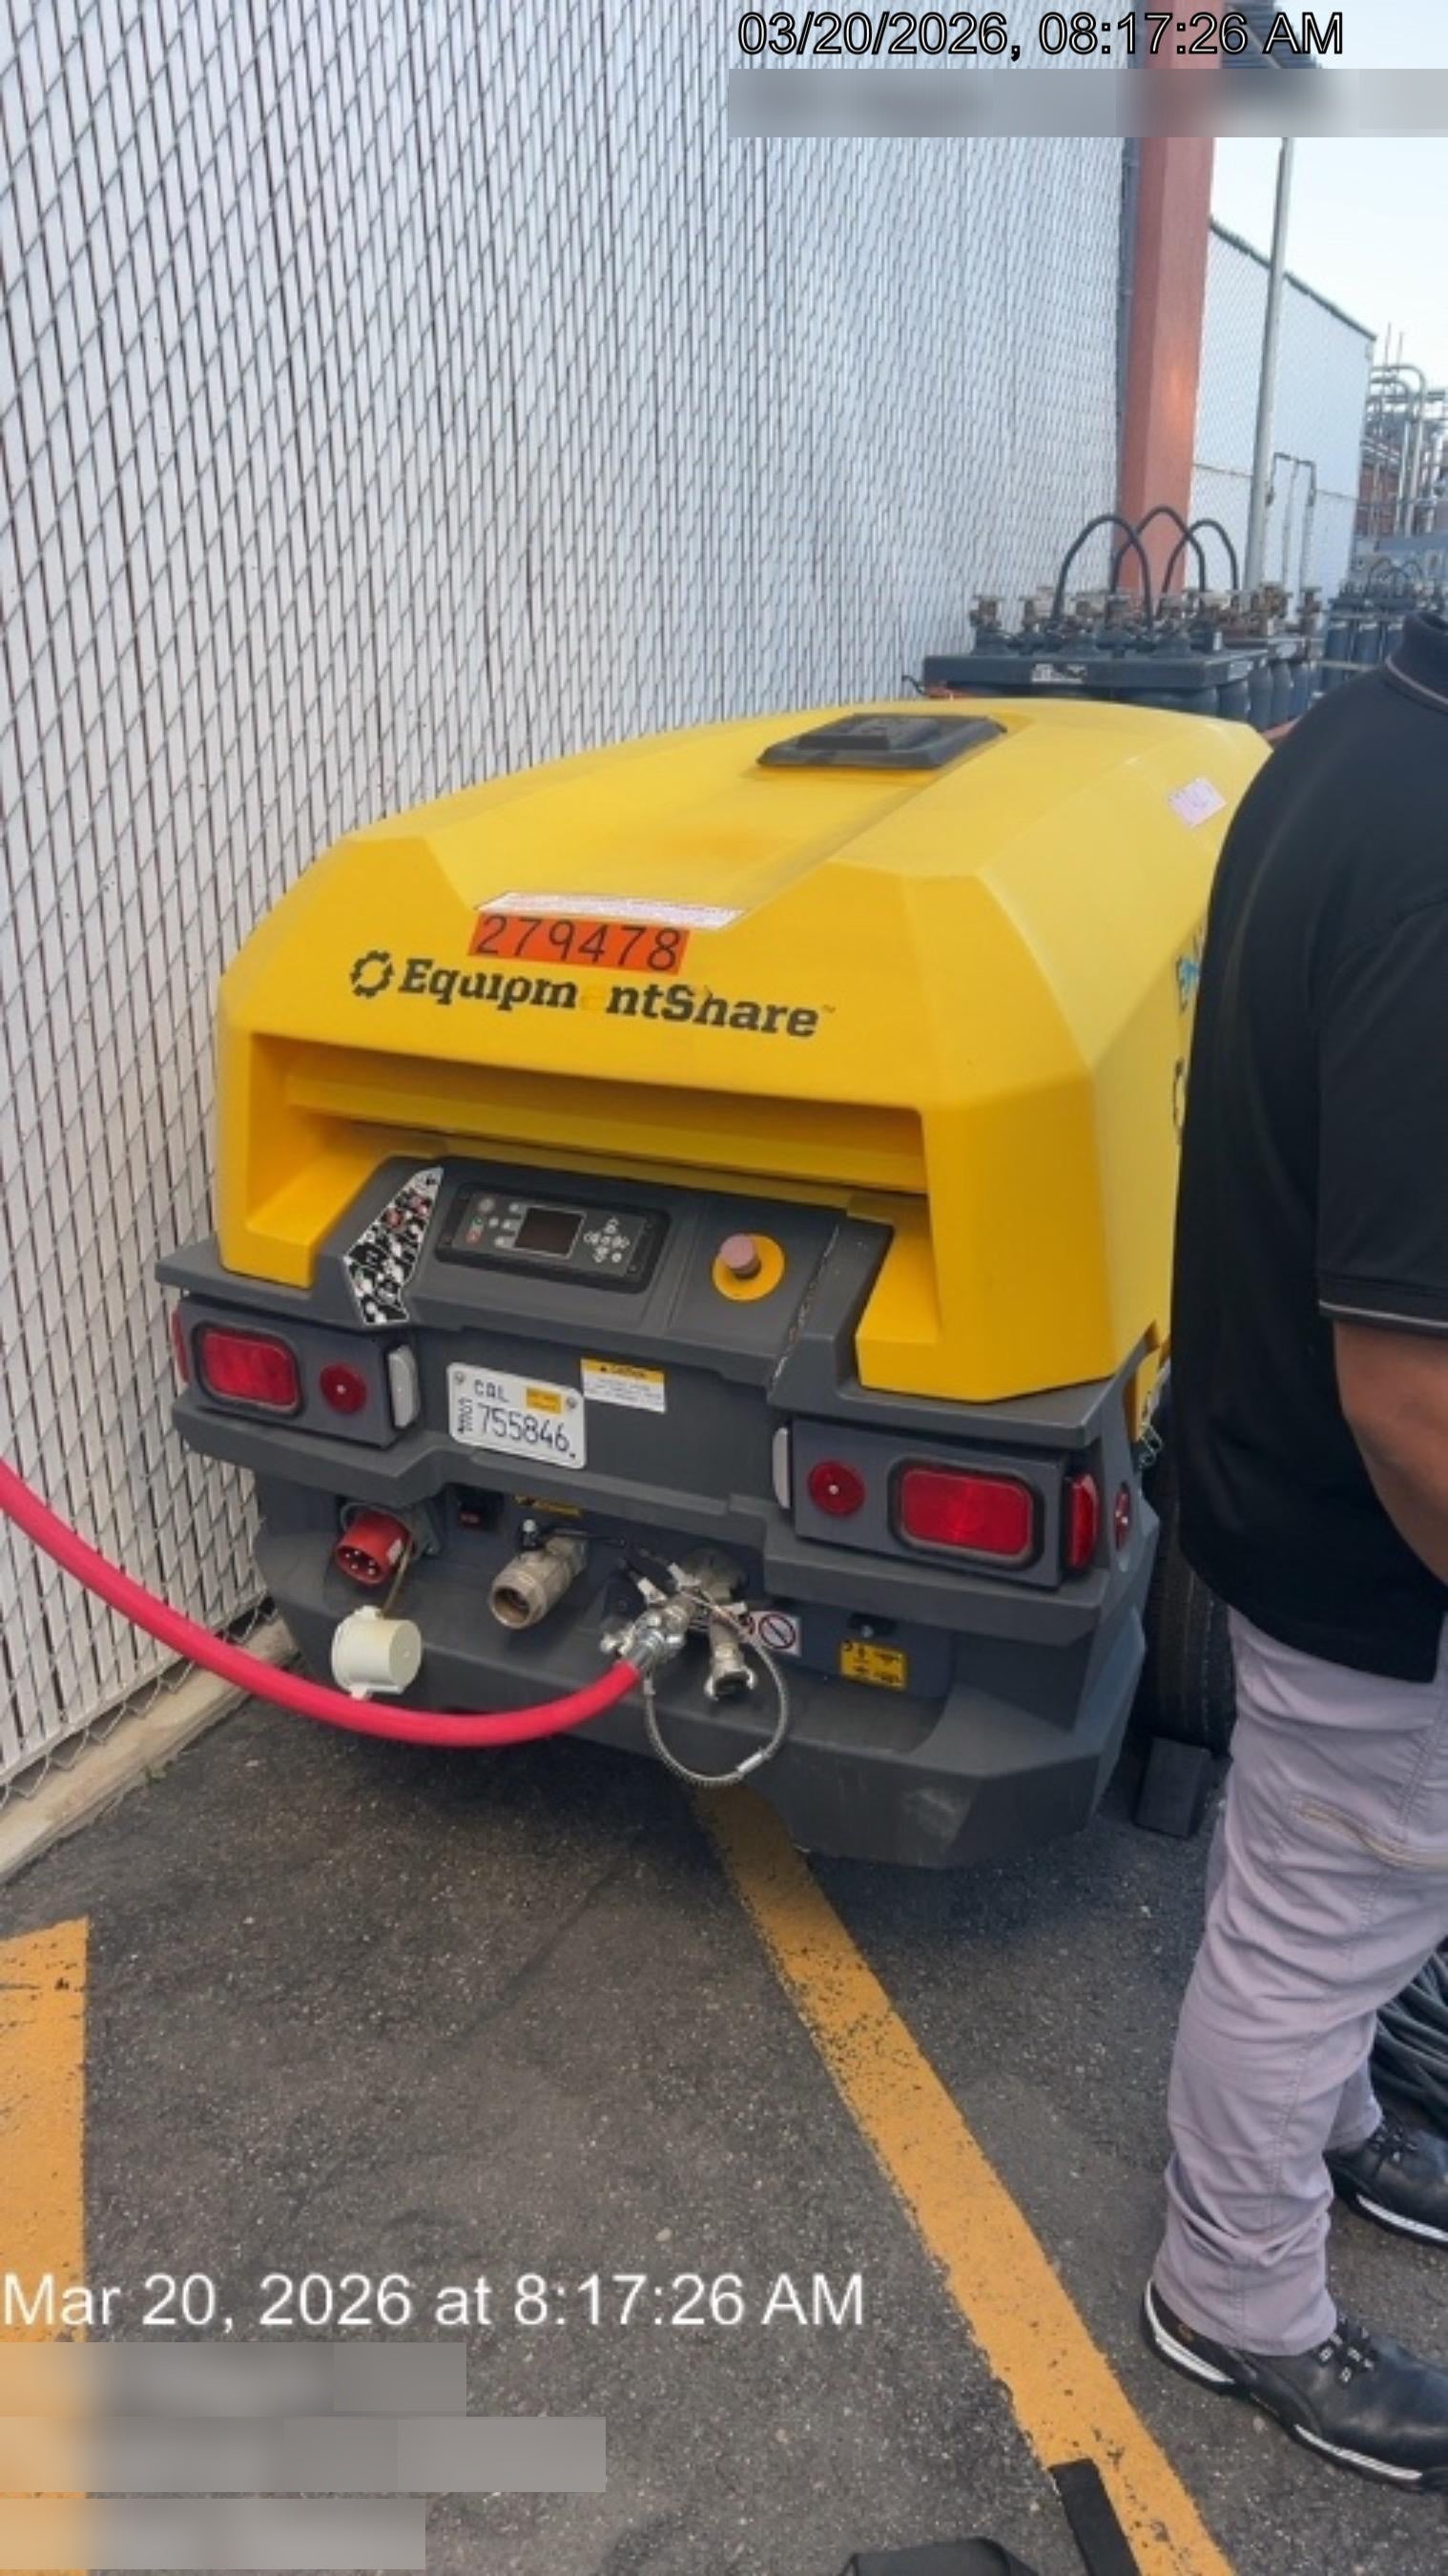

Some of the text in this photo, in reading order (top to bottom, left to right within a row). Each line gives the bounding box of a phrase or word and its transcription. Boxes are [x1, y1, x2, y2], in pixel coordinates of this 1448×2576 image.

[475, 913, 680, 971] 279478
[399, 958, 818, 1038] EquipmntShare
[477, 1402, 569, 1451] 755846
